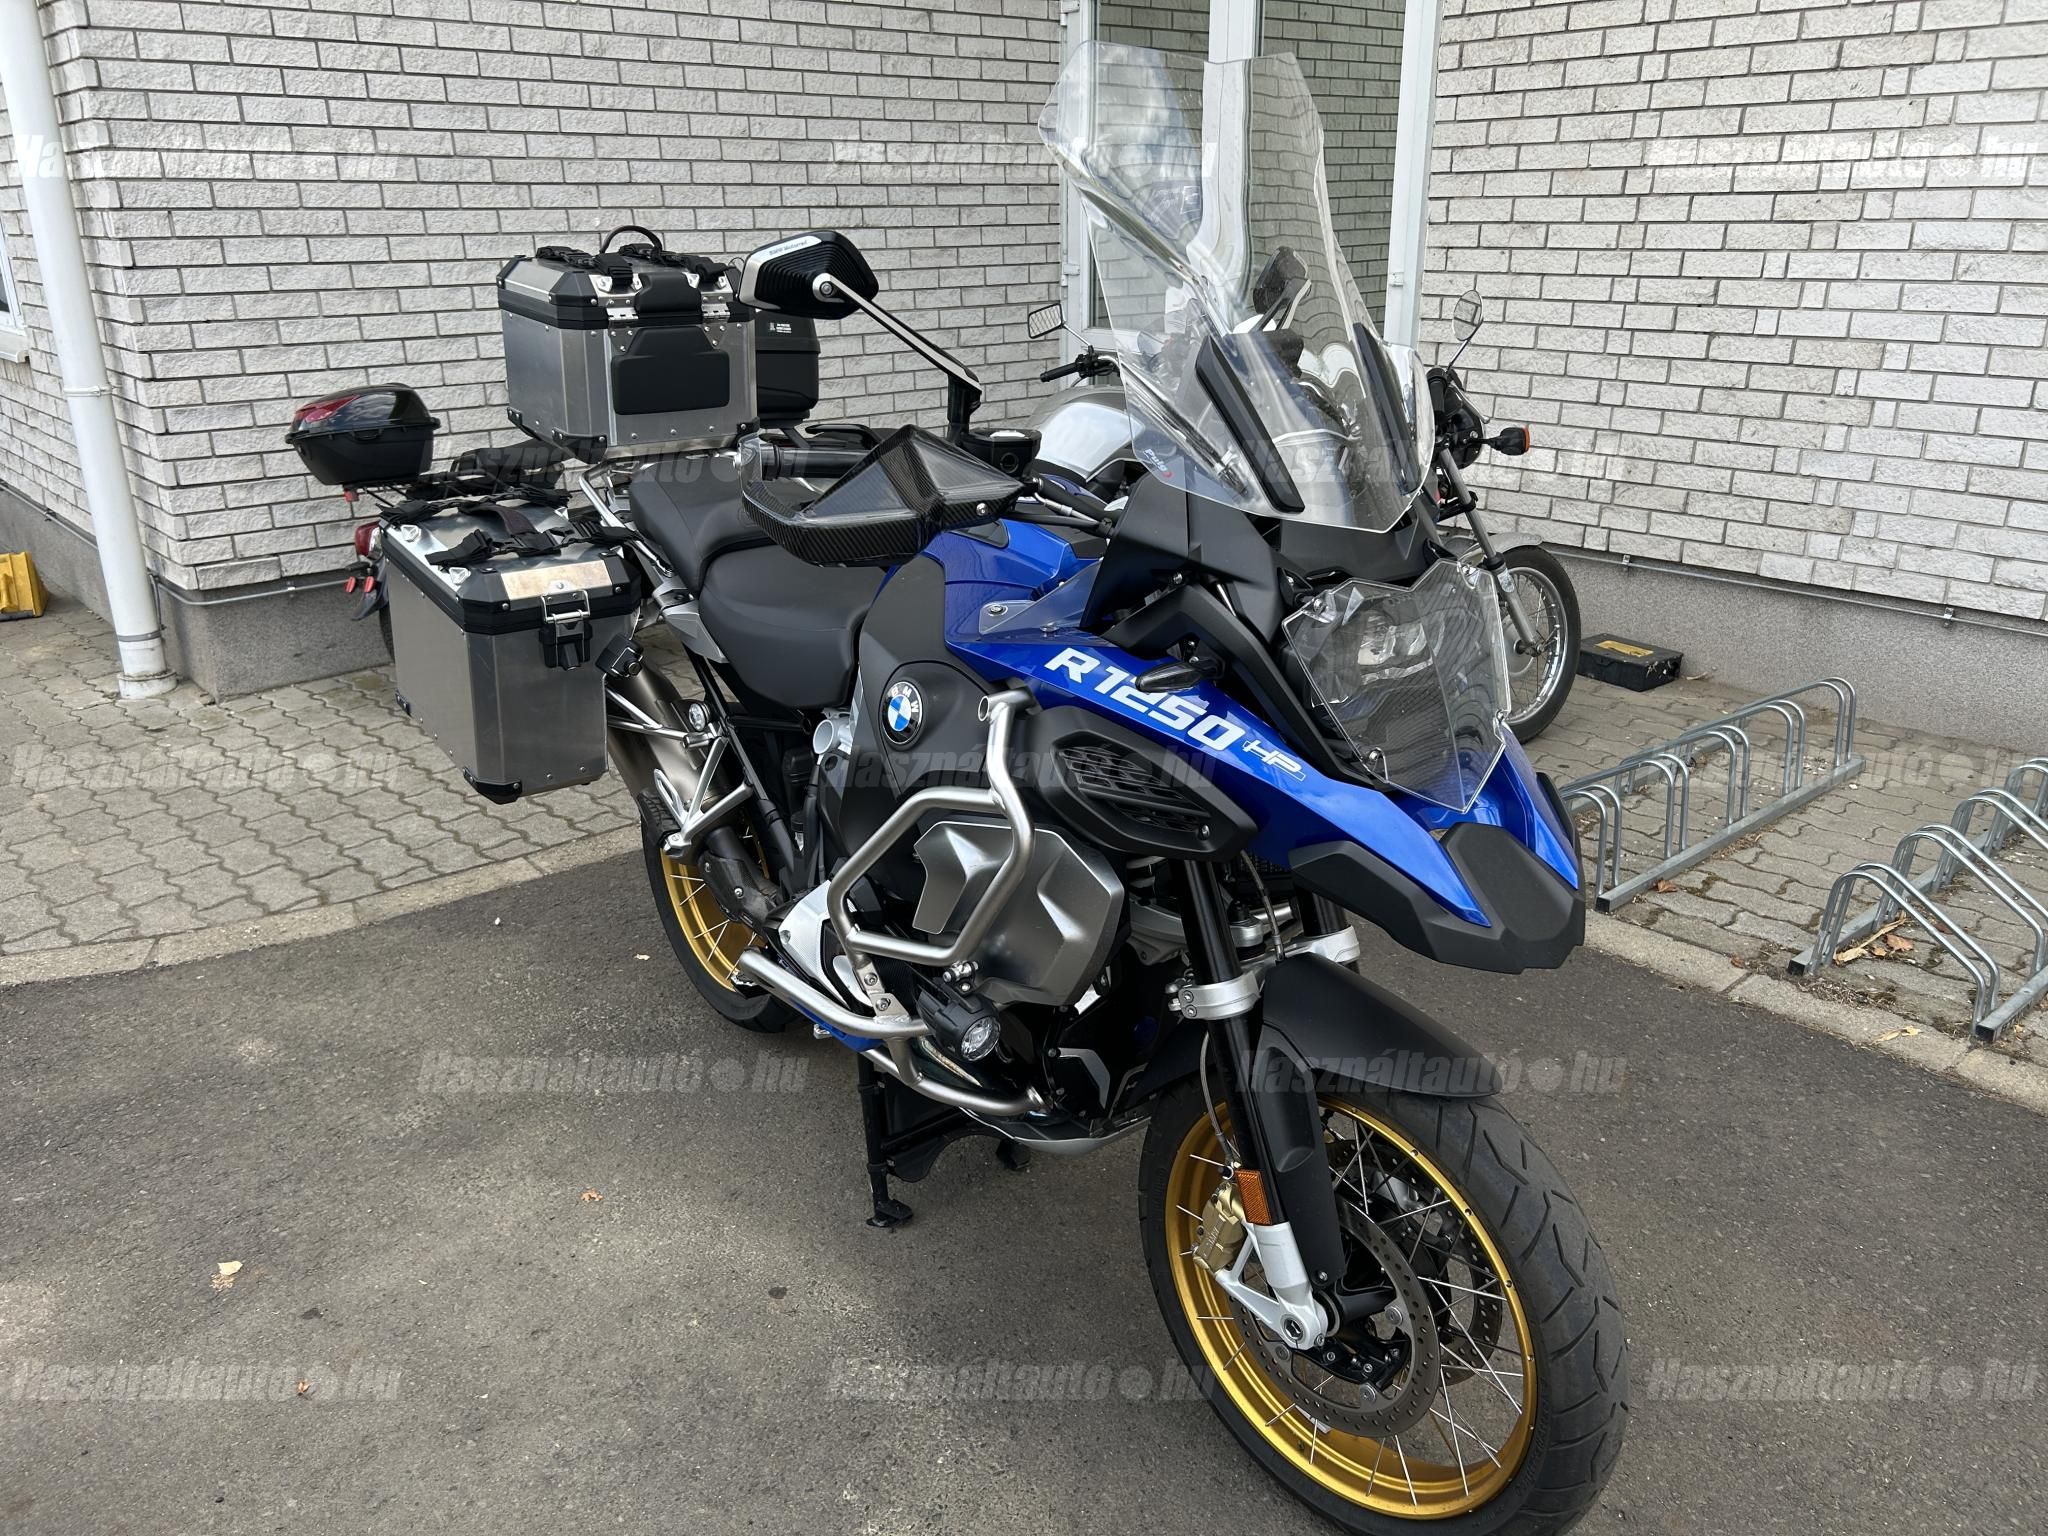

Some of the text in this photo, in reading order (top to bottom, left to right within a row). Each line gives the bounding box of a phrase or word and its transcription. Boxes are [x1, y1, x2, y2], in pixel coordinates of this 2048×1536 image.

[1144, 448, 1168, 472] Puig
[890, 685, 920, 713] BMW
[1044, 647, 1304, 775] R 1250 HP
